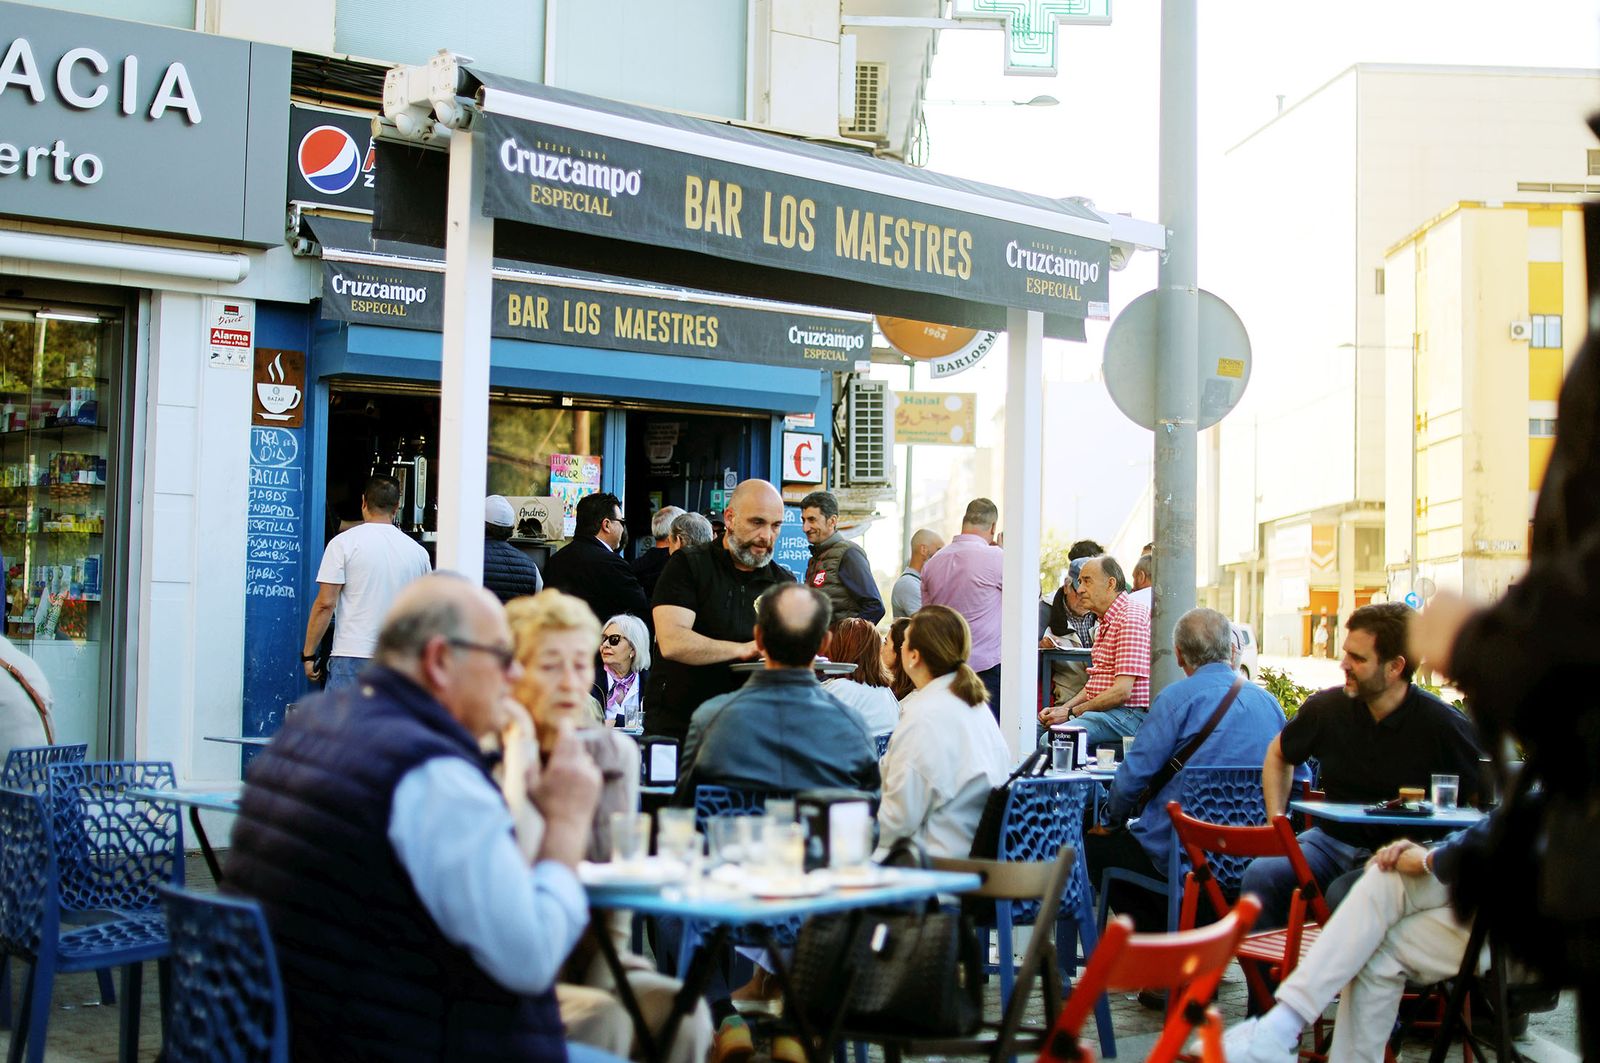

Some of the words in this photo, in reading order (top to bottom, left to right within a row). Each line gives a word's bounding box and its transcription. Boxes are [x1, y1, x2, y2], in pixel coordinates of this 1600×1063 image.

[0, 37, 202, 124] ACIA
[0, 139, 104, 184] erto
[500, 137, 641, 198] Cruzcampo
[530, 182, 613, 217] ESPECIAL
[684, 174, 743, 240] BAR
[762, 191, 817, 252] LOS
[834, 205, 973, 281] MAESTRES
[1006, 240, 1099, 285] Cruzcampo
[332, 273, 427, 305] Cruzcampo
[1026, 276, 1081, 302] ESPECIAL
[351, 299, 407, 316] ESPECIAL
[508, 293, 549, 330] BAR
[562, 299, 601, 336] LOS
[614, 305, 720, 348] MAESTRES
[212, 329, 249, 342] Alarma
[788, 325, 864, 352] Cruzcampo
[804, 347, 848, 362] ESPECIAL
[936, 358, 964, 373] BAR
[965, 343, 987, 365] LOS
[793, 440, 812, 477] C
